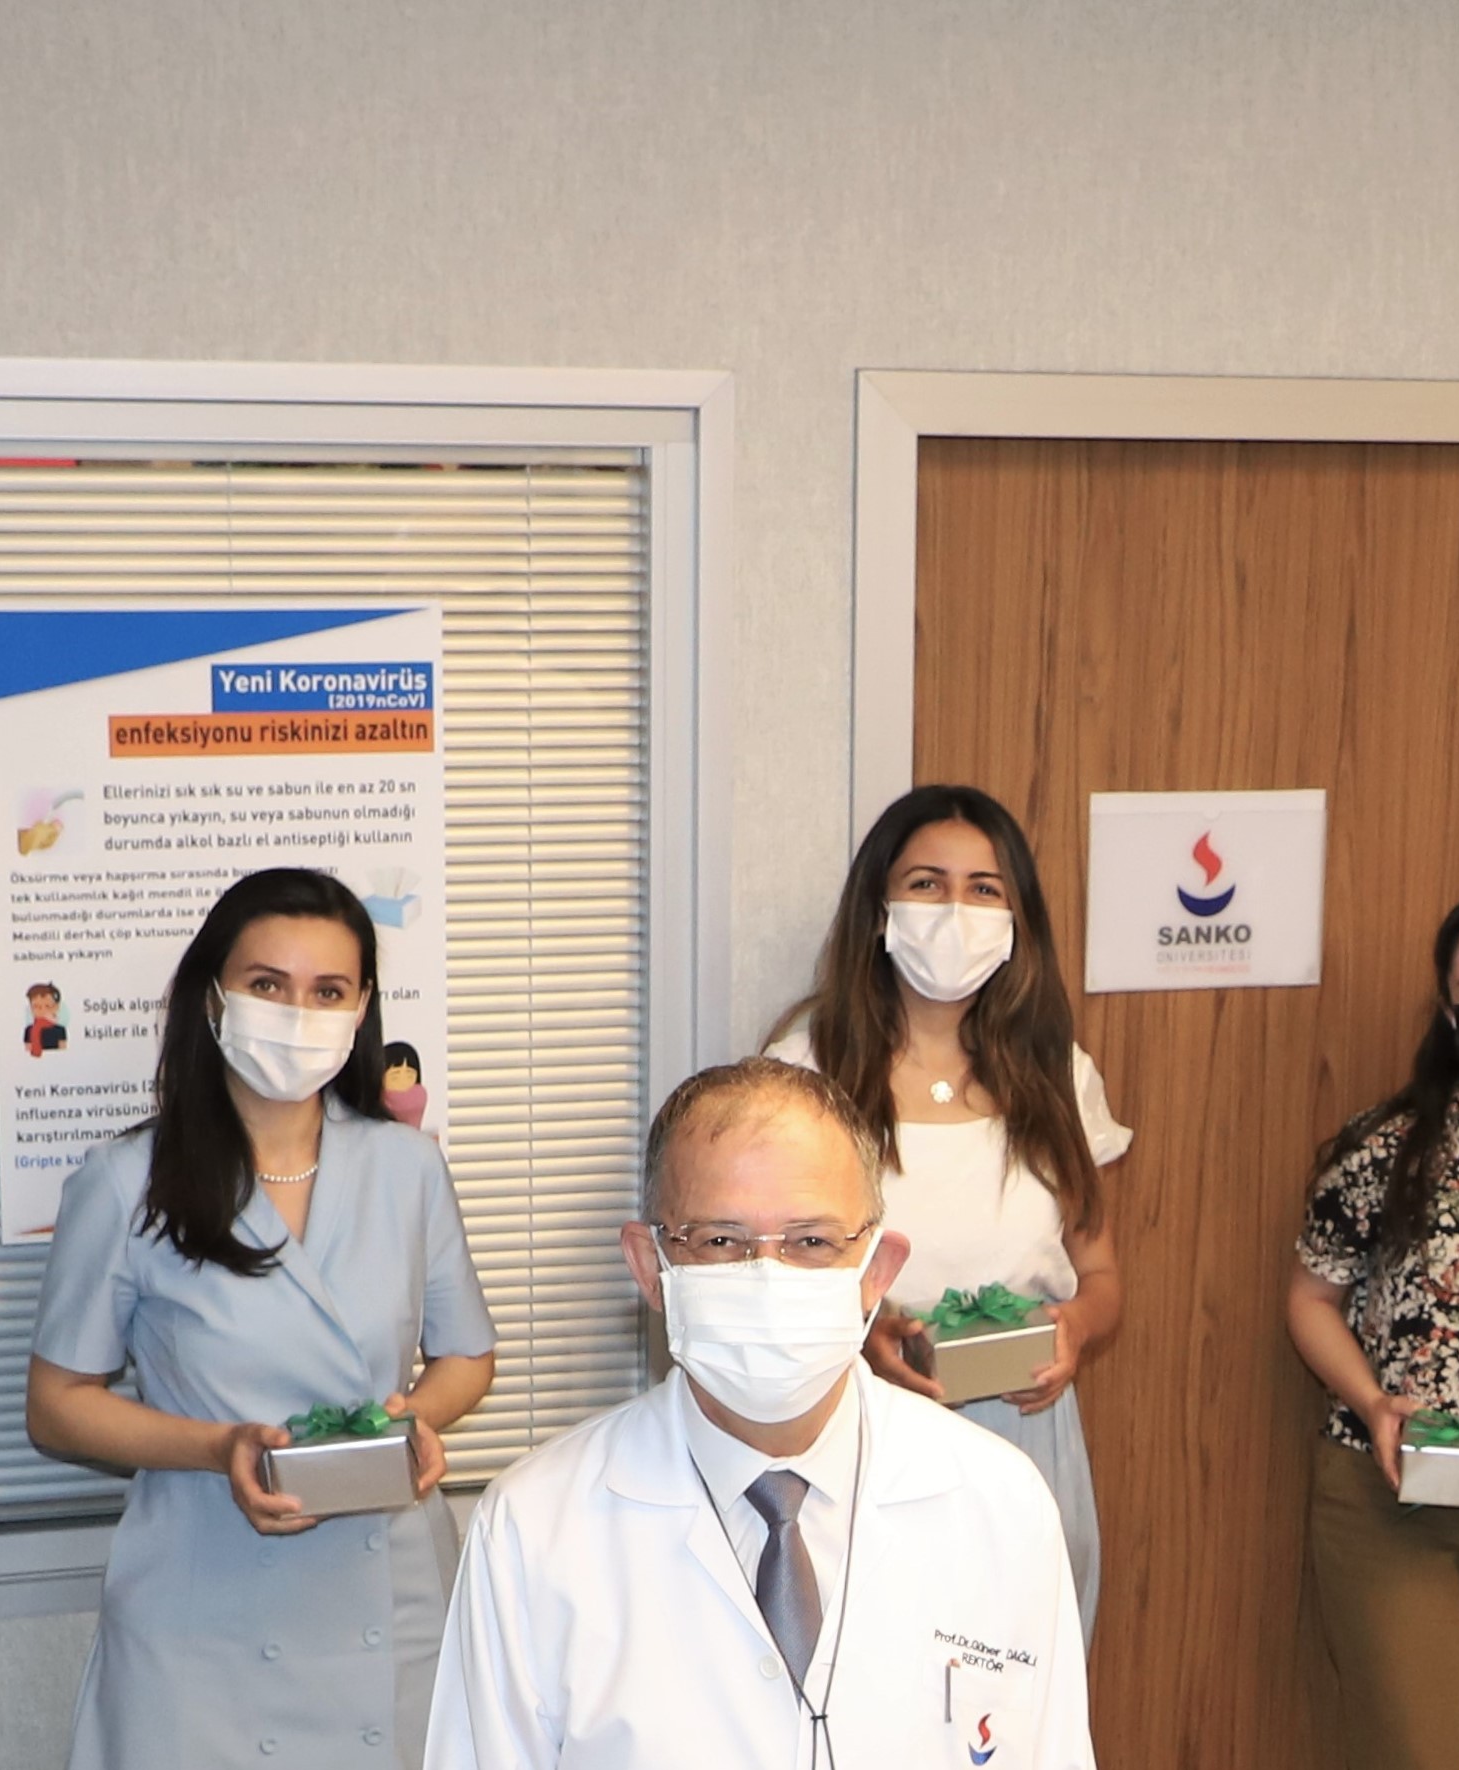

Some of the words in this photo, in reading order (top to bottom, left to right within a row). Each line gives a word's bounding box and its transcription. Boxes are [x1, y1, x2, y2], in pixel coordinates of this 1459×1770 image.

[219, 671, 272, 694] Yeni
[279, 668, 427, 692] Koronavirüs
[328, 693, 425, 710] (2019nCoV)
[116, 722, 252, 748] enfeksiyonu
[260, 718, 348, 742] riskinizi
[355, 719, 428, 741] azaltın
[103, 785, 171, 800] Ellerinizi
[175, 784, 196, 798] sık
[201, 783, 221, 797] sık
[226, 786, 243, 797] su
[247, 786, 263, 796] ve
[268, 782, 312, 795] sabun
[316, 781, 333, 794] ile
[337, 783, 355, 794] en
[359, 783, 375, 793] az
[379, 781, 395, 793] 20
[400, 783, 416, 793] sn
[104, 811, 165, 829] boyunca
[169, 810, 225, 826] yıkayın,
[230, 811, 246, 823] su
[251, 810, 284, 824] veya
[288, 807, 349, 821] sabunun
[354, 805, 415, 821] olmadığı
[104, 836, 172, 851] durumda
[176, 834, 213, 848] alkol
[217, 833, 252, 847] bazlı
[256, 832, 269, 846] el
[274, 831, 349, 849] antiseptiği
[354, 830, 412, 844] kullanın
[10, 870, 69, 885] Öksürme
[73, 872, 102, 885] veya
[106, 869, 166, 884] hapşırma
[170, 868, 228, 881] sırasında
[11, 891, 31, 904] tek
[35, 889, 108, 903] kullanımlık
[112, 888, 144, 902] kağıt
[148, 887, 192, 899] mendil
[195, 887, 211, 898] ile
[12, 909, 92, 924] bulunmadığı
[96, 908, 173, 921] durumlarda
[176, 908, 194, 919] ise
[12, 929, 60, 943] Mendili
[63, 928, 106, 941] derhal
[109, 928, 132, 943] çöp
[135, 925, 195, 938] kutusuna
[1158, 924, 1252, 946] SANKO
[13, 949, 64, 962] sabunla
[67, 949, 113, 963] yıkayın
[392, 988, 420, 1000] olan
[83, 998, 125, 1014] Soğuk
[84, 1026, 127, 1040] kişiler
[132, 1025, 148, 1037] ile
[15, 1086, 46, 1098] Yeni
[50, 1082, 139, 1098] Koronavirüs
[16, 1106, 82, 1121] influenza
[87, 1104, 158, 1118] virüsünün
[15, 1154, 62, 1169] (Gripte
[962, 1652, 1004, 1673] REKTÖR
